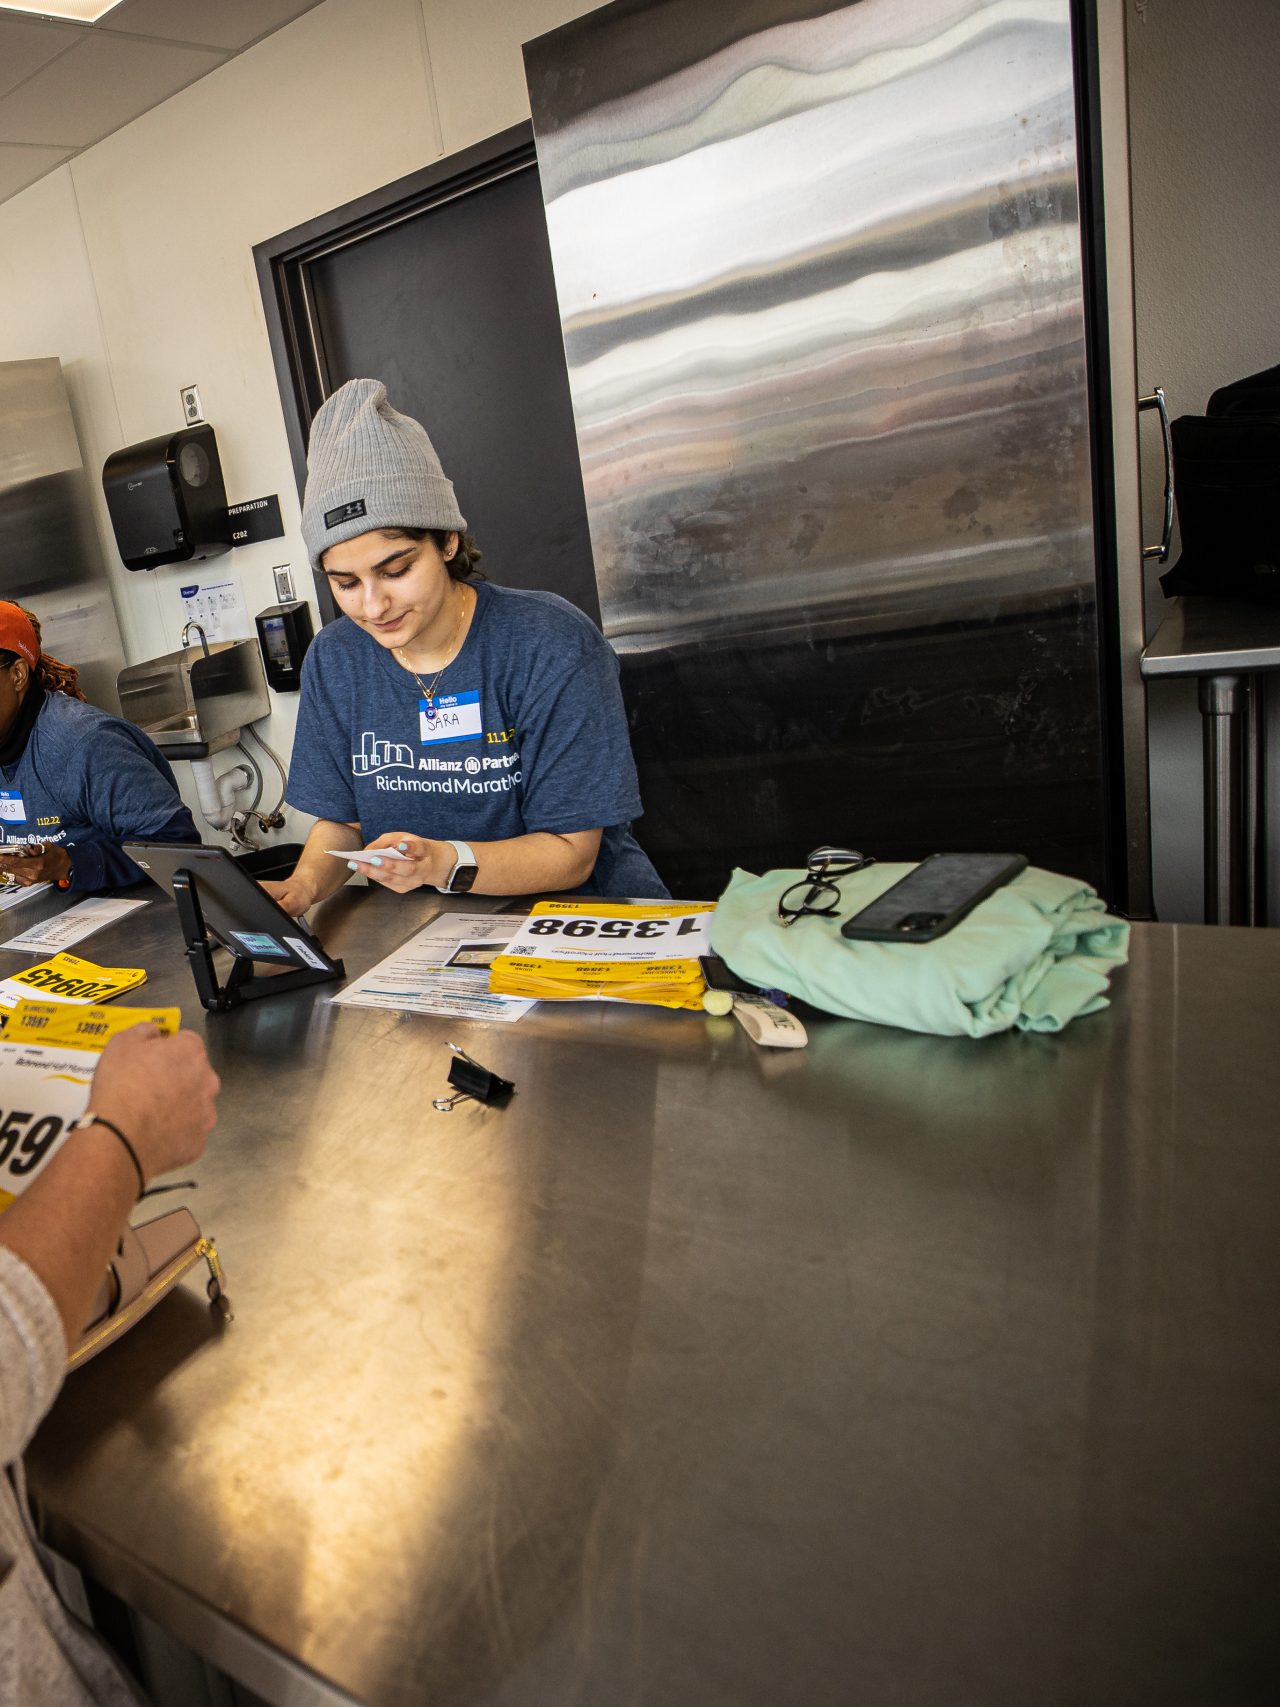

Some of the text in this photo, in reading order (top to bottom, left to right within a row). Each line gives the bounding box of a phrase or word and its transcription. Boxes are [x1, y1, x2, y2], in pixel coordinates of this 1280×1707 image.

[228, 499, 268, 516] PREPARATION
[232, 530, 248, 540] C202
[439, 696, 458, 704] Hello
[426, 713, 460, 731] SARA
[418, 758, 463, 771] Allianz
[6, 829, 67, 845] Allianz Partners
[528, 918, 701, 939] 13598
[19, 968, 119, 998] 20945
